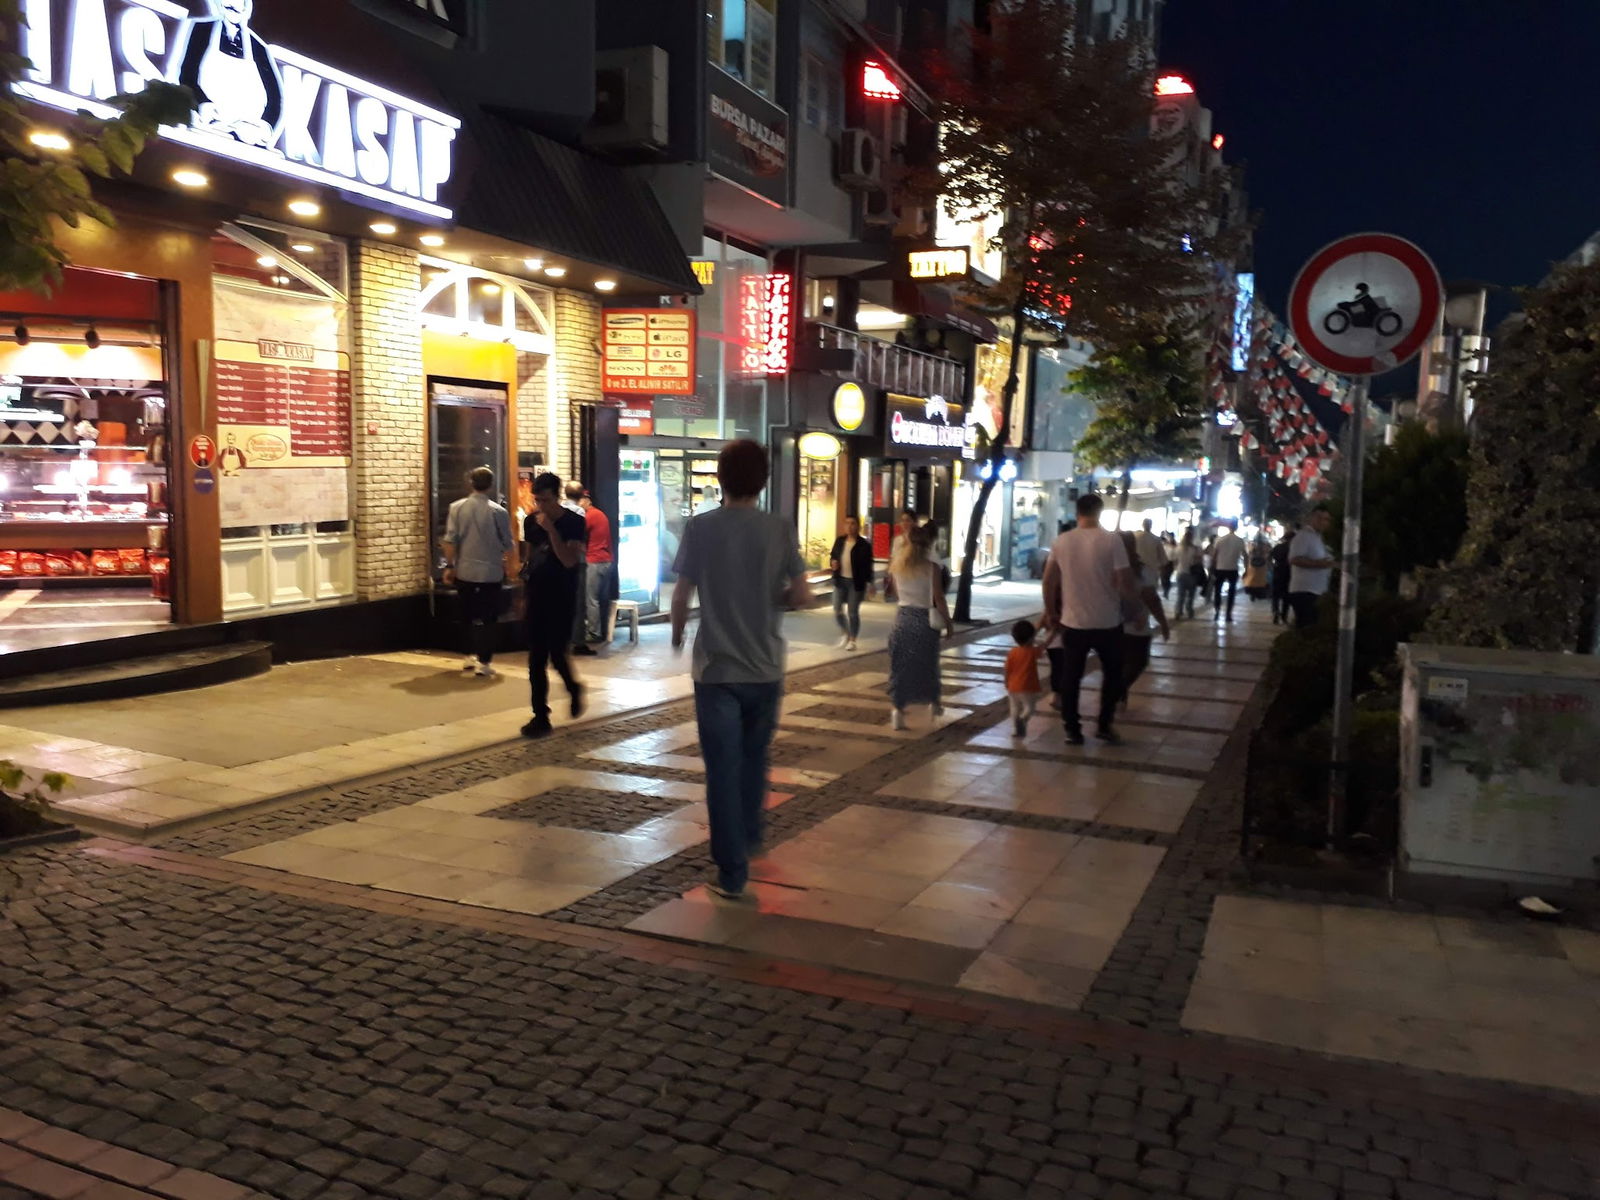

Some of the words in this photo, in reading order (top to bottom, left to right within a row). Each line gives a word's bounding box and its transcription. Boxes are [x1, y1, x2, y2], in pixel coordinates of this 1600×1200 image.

[711, 94, 749, 132] BURSA
[278, 64, 456, 202] KASAP
[767, 279, 786, 368] TATTOO
[666, 350, 682, 358] LG
[628, 379, 638, 388] EL
[662, 380, 688, 390] SATILIR
